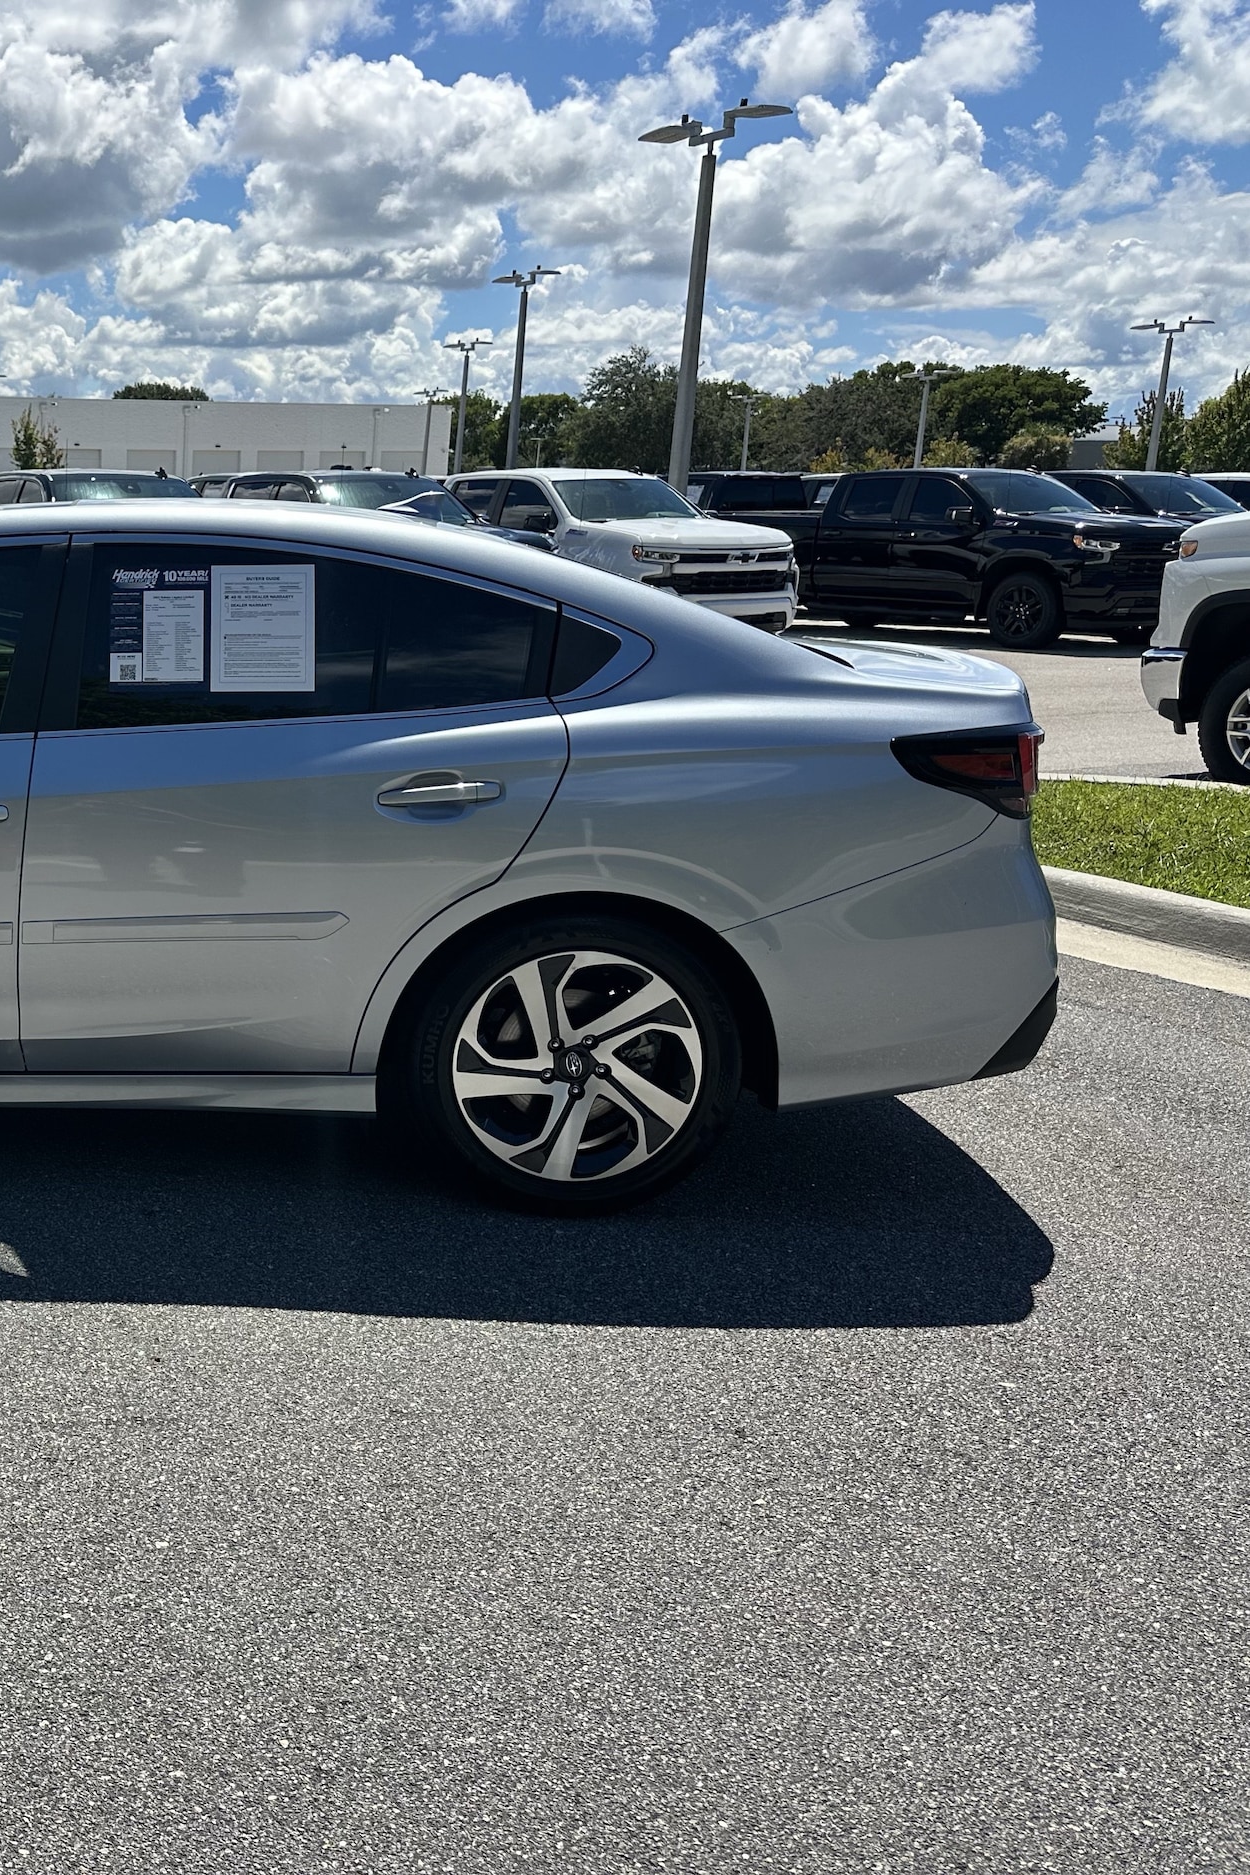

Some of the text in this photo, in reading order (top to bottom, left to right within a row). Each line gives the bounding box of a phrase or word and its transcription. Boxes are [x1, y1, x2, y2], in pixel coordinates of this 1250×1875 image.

[112, 568, 160, 582] Hendrick
[163, 570, 177, 582] 10
[421, 1003, 451, 1085] KUMHO
